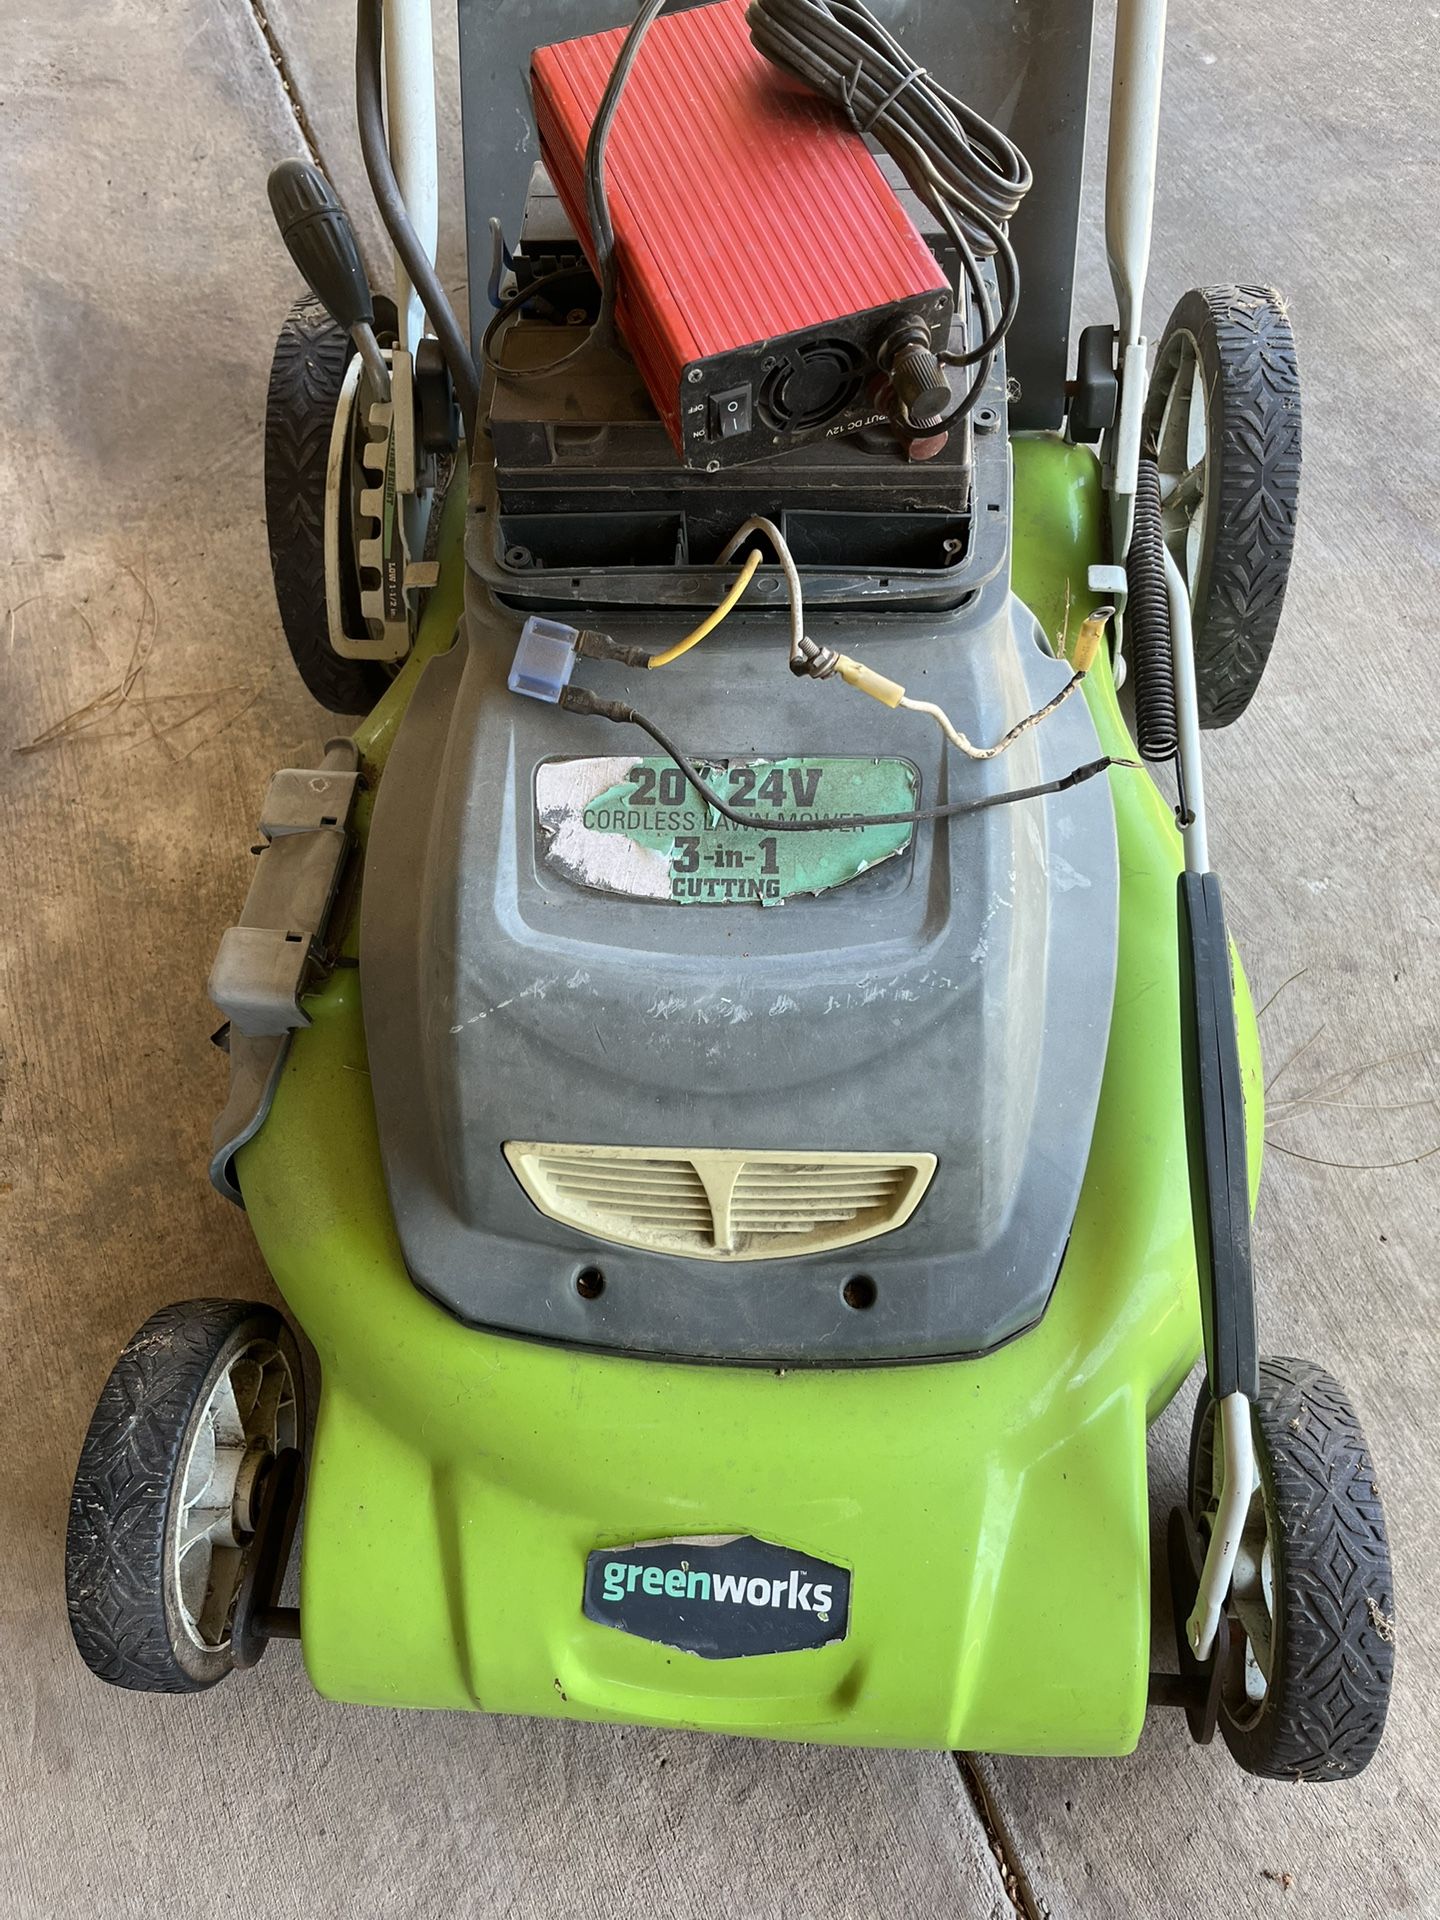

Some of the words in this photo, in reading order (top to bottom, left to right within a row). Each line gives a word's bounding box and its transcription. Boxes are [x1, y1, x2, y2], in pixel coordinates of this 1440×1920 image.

[688, 404, 704, 414] OFF
[693, 430, 705, 438] ON
[825, 425, 844, 437] 12V
[847, 419, 863, 430] DC
[388, 562, 396, 582] LOW
[728, 768, 823, 807] 24V
[583, 809, 695, 831] CORDLESS
[673, 836, 780, 874] 3-in-1
[672, 878, 780, 898] CUTTING
[602, 1561, 833, 1613] greenworks
